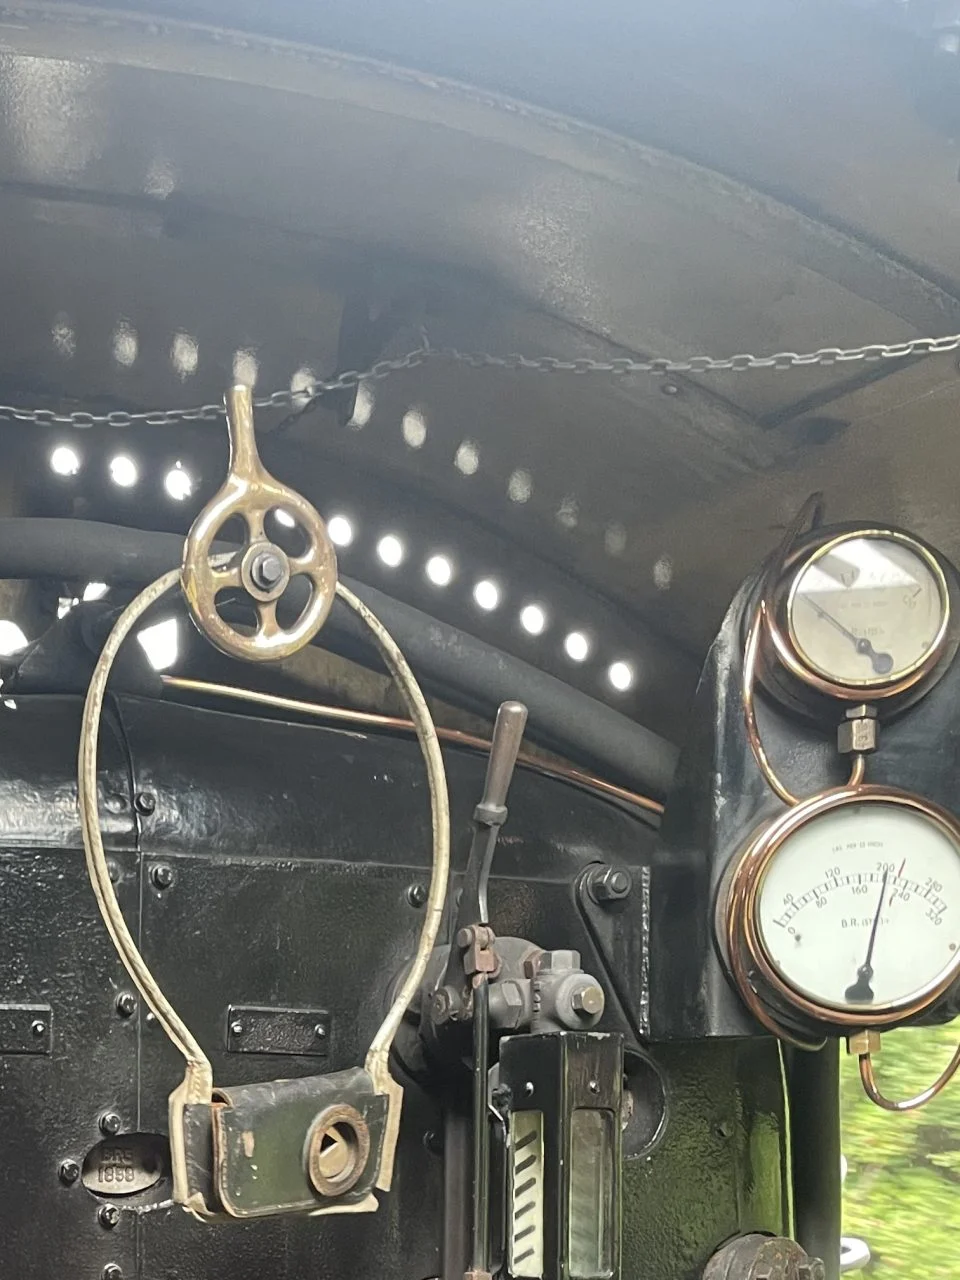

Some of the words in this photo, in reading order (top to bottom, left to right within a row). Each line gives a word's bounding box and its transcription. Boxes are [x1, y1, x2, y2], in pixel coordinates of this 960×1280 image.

[825, 867, 841, 879] 120
[876, 862, 895, 873] 200
[852, 884, 868, 895] 160
[925, 876, 943, 893] 280
[783, 893, 794, 906] 40
[815, 897, 828, 909] 80
[925, 907, 943, 926] 320
[788, 926, 796, 935] 0
